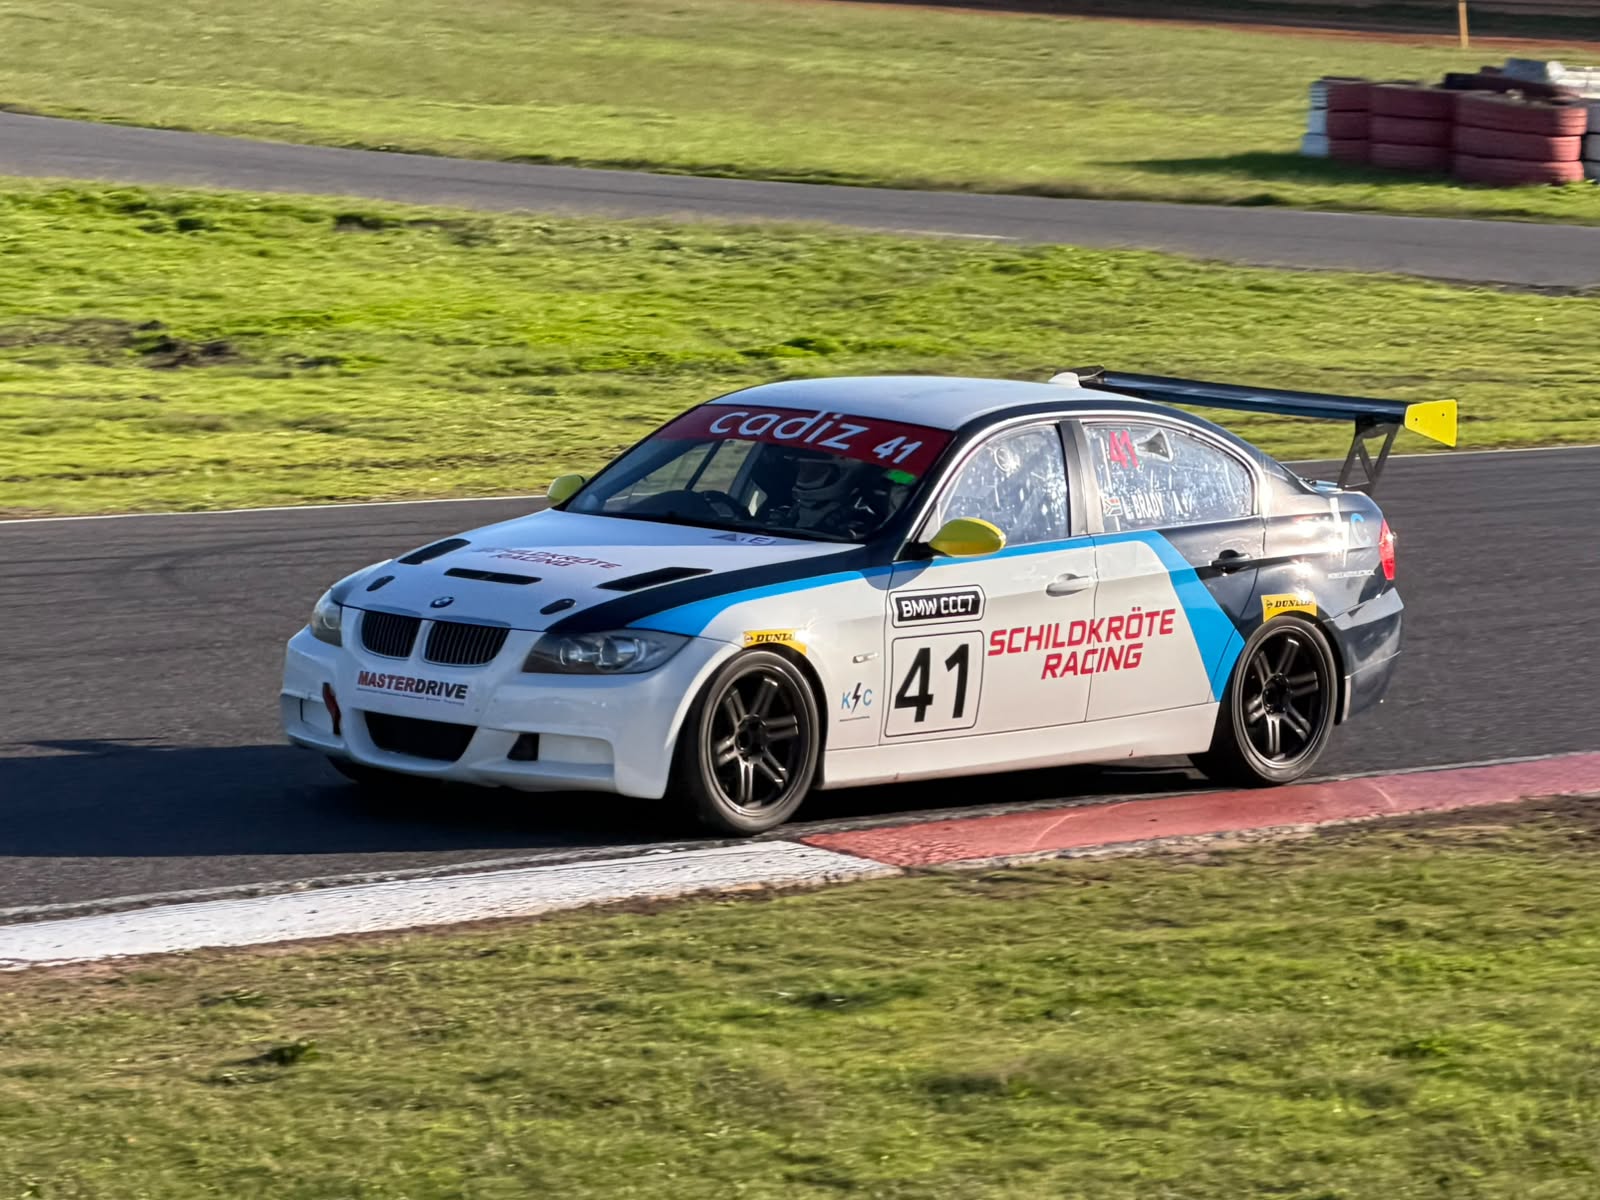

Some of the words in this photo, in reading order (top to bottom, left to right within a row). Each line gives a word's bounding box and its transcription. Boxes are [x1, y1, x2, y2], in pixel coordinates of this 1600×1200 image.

[709, 410, 869, 450] cadiz
[872, 436, 923, 464] 41
[1110, 429, 1139, 469] 41
[901, 598, 937, 618] BMW
[940, 595, 975, 614] CCCT
[987, 606, 1176, 656] SCHILDKRÖTE
[1041, 642, 1143, 680] RACING
[357, 670, 468, 700] MASTERDRIVE
[894, 643, 969, 723] 41
